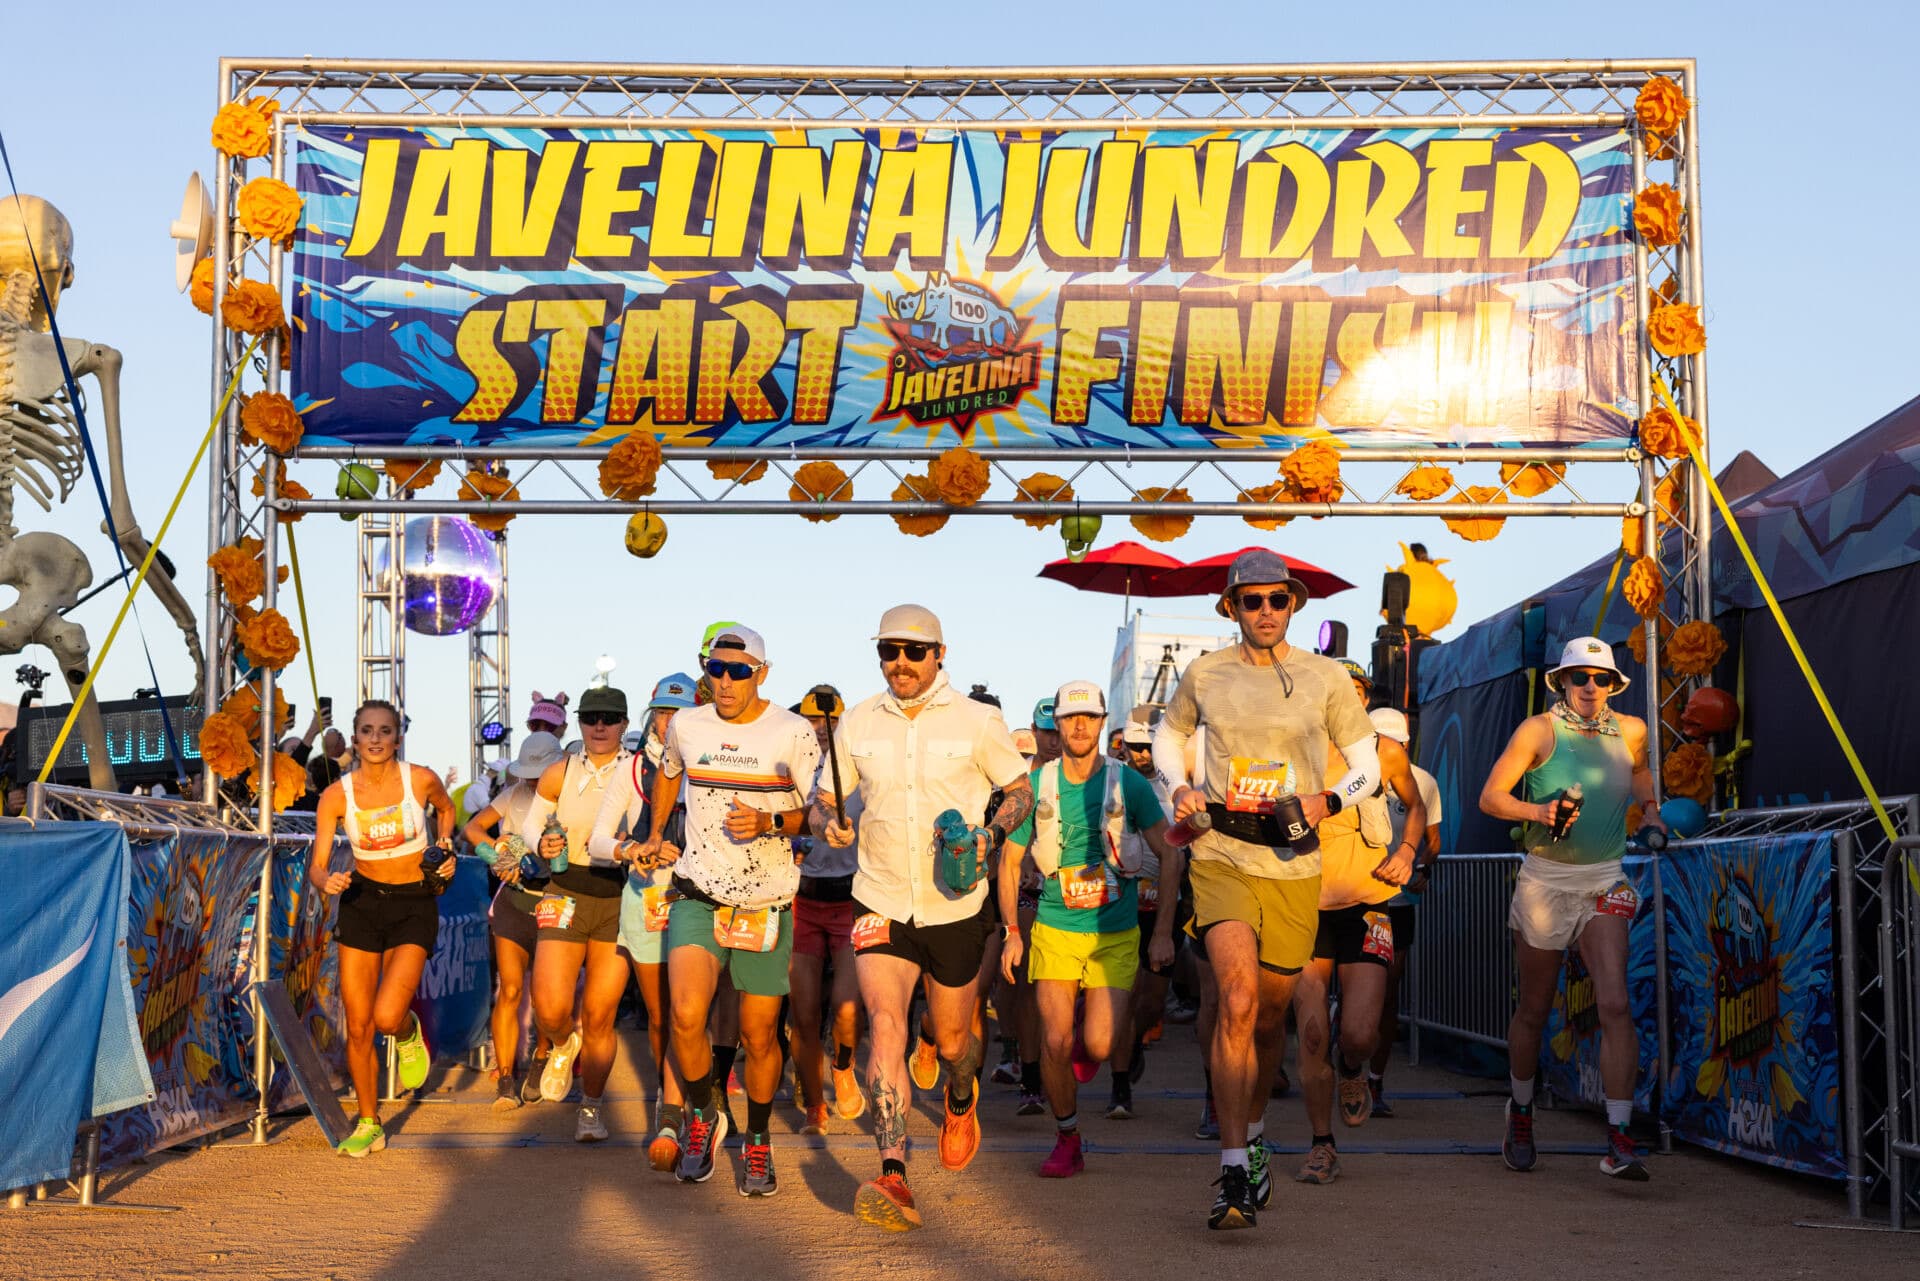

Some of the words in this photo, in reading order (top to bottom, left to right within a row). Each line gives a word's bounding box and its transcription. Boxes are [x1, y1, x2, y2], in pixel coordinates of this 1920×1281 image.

[345, 138, 954, 260] JAVELINA
[991, 139, 1582, 261] JUNDRED
[954, 301, 986, 318] 100
[452, 298, 862, 425] START
[887, 352, 1034, 412] JAVELINA
[921, 390, 1008, 419] JUNDRED
[713, 754, 759, 766] ARAVAIPA
[1239, 776, 1279, 796] 1237
[1728, 1097, 1776, 1150] HOKA
